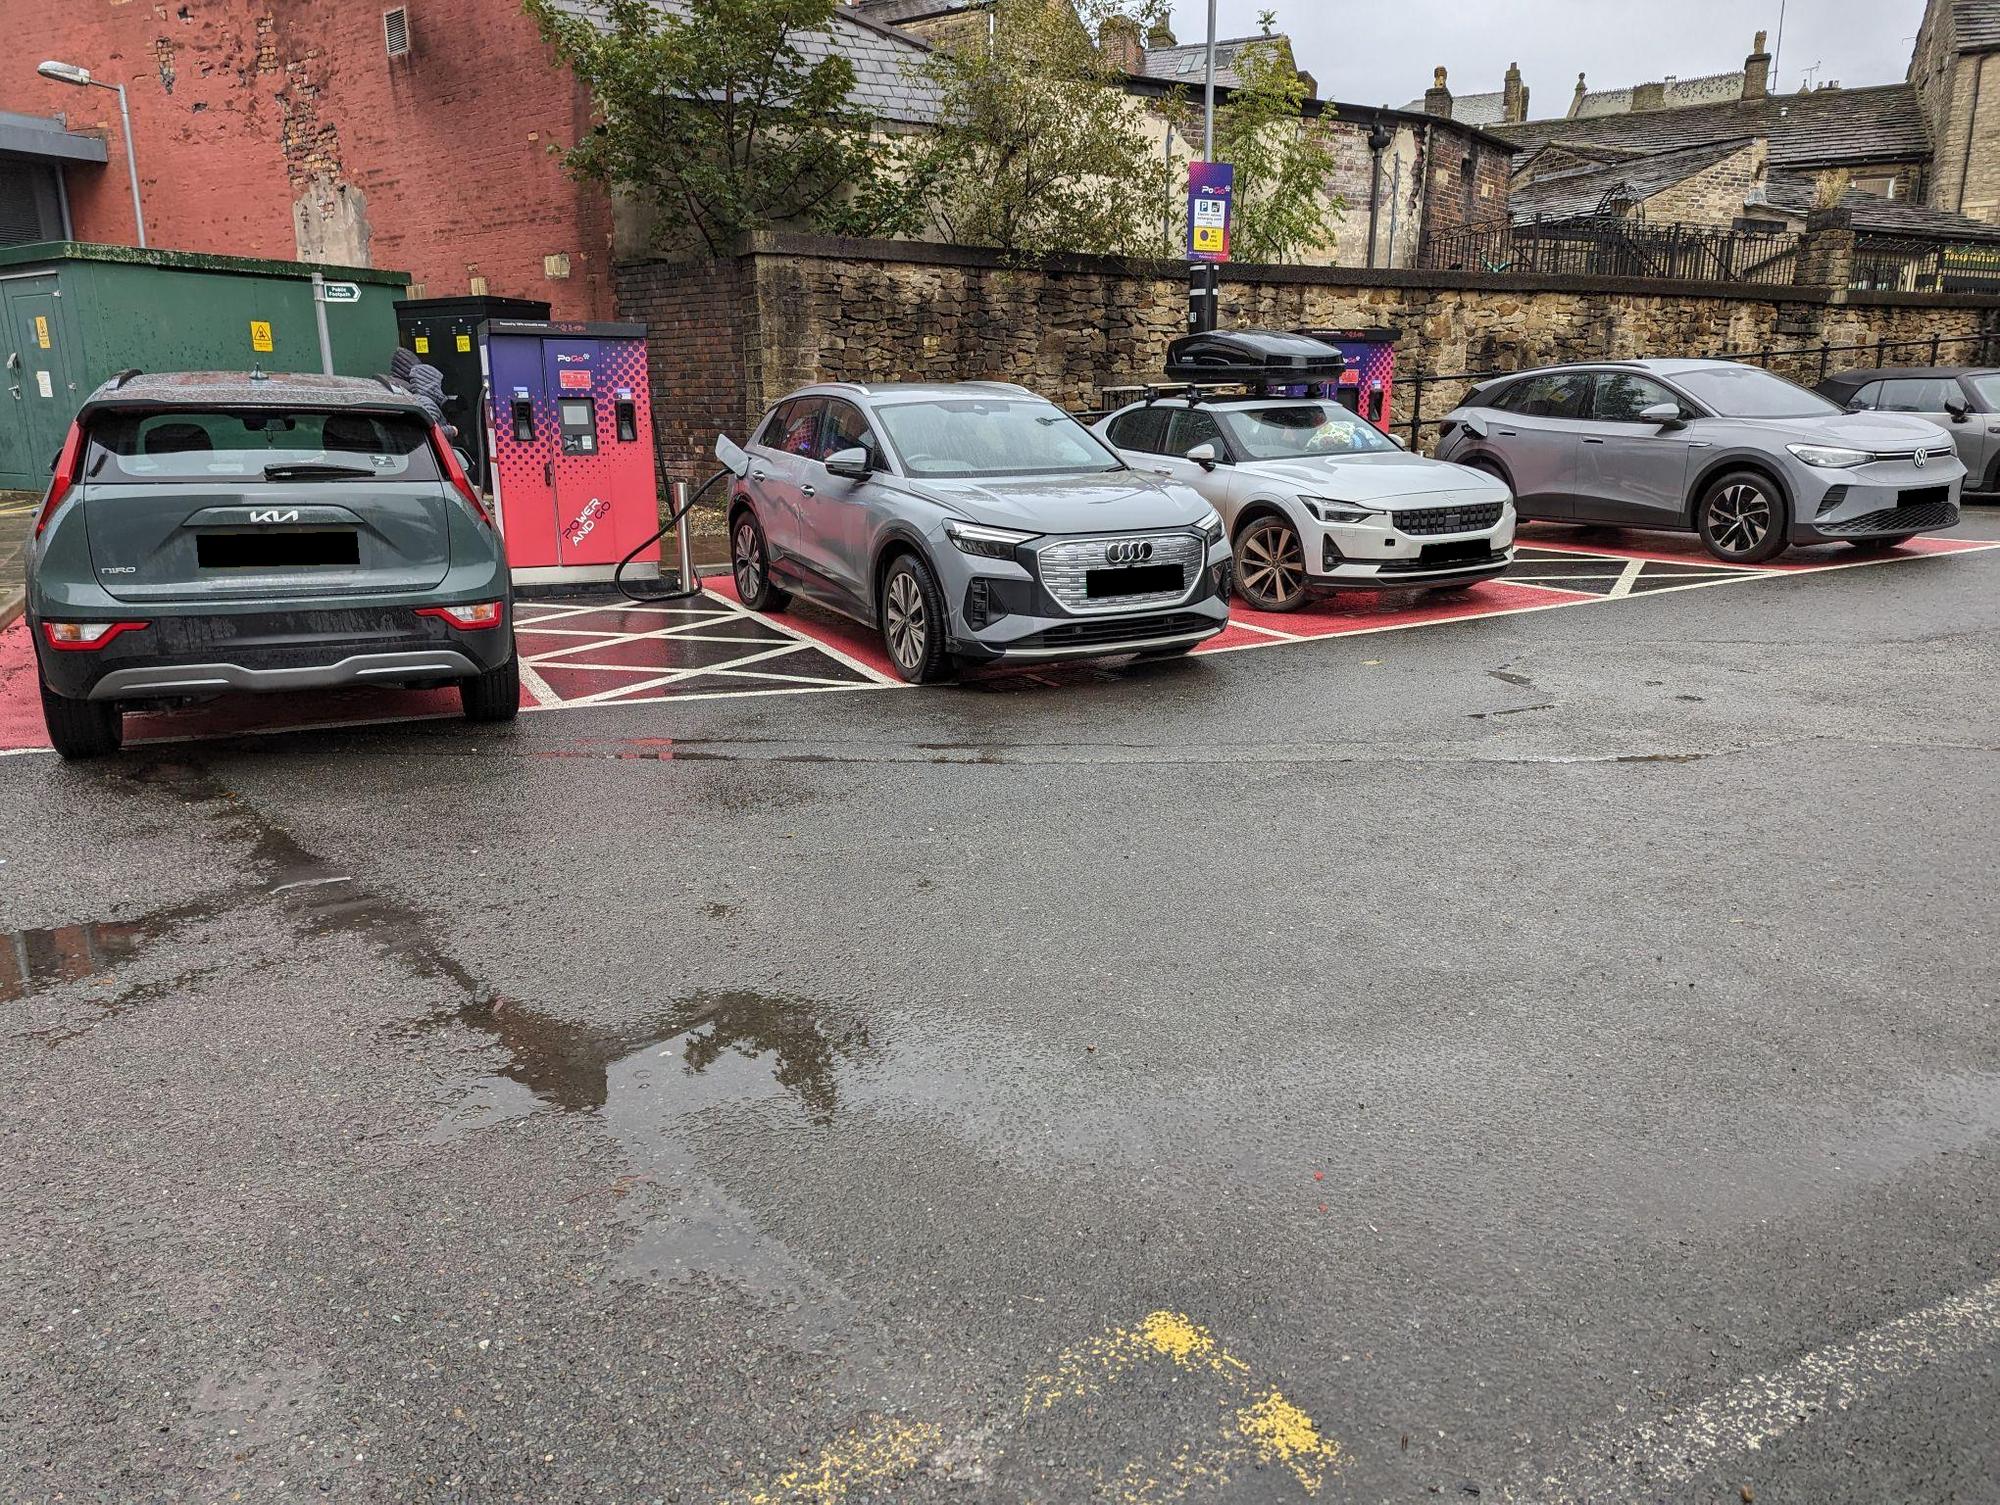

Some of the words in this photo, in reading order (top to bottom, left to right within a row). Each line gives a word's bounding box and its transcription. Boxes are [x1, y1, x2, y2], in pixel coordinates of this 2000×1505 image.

[1202, 186, 1225, 195] PoGo
[557, 354, 584, 362] PoGo
[562, 498, 600, 540] POWER
[572, 520, 595, 546] AND
[595, 501, 611, 519] GO
